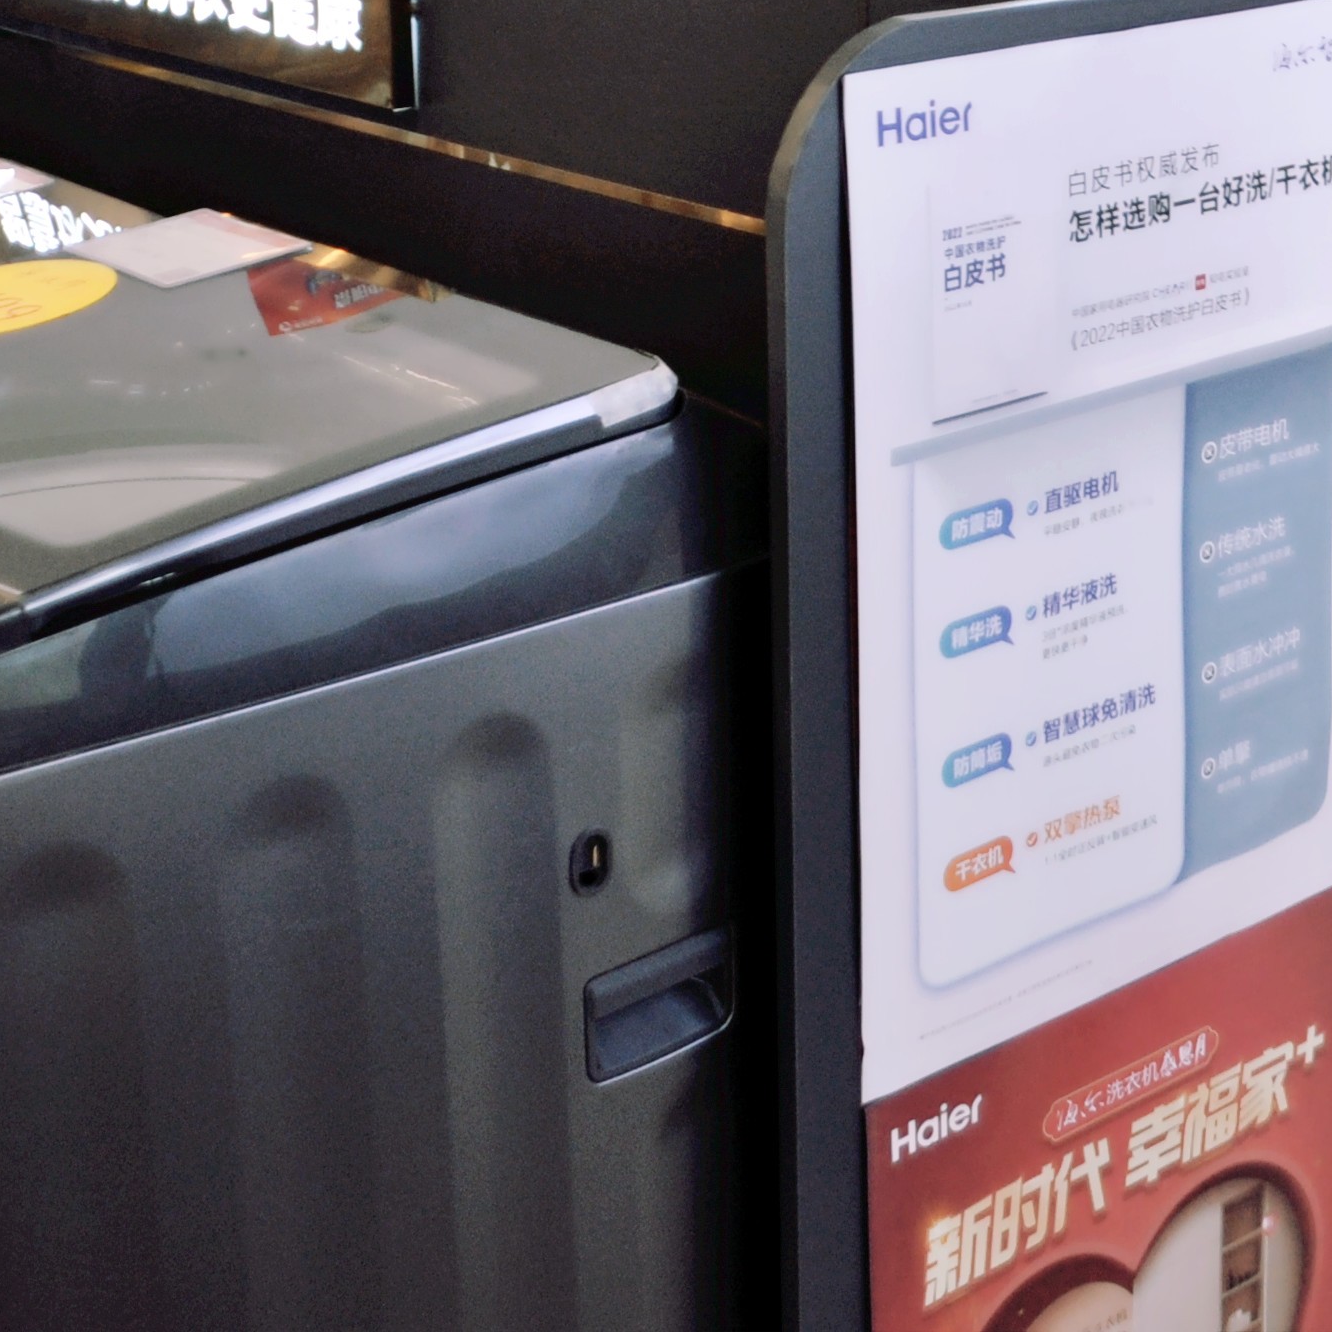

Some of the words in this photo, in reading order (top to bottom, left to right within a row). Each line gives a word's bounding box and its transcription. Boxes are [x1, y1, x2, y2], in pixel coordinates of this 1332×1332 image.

[876, 99, 972, 148] Haier
[1068, 142, 1220, 198] 白皮书权威发布
[944, 252, 1006, 293] 白皮书
[1219, 418, 1290, 459] 皮带电机
[1044, 470, 1119, 514] 直驱电机
[951, 507, 1004, 542] 防震动
[1042, 573, 1118, 618] 精华液洗
[951, 615, 1004, 650] 精华洗
[1042, 683, 1157, 743] 智慧球免清洗
[955, 844, 1005, 881] 干衣机
[890, 1093, 984, 1164] Haier
[922, 1136, 1112, 1310] 新时代
